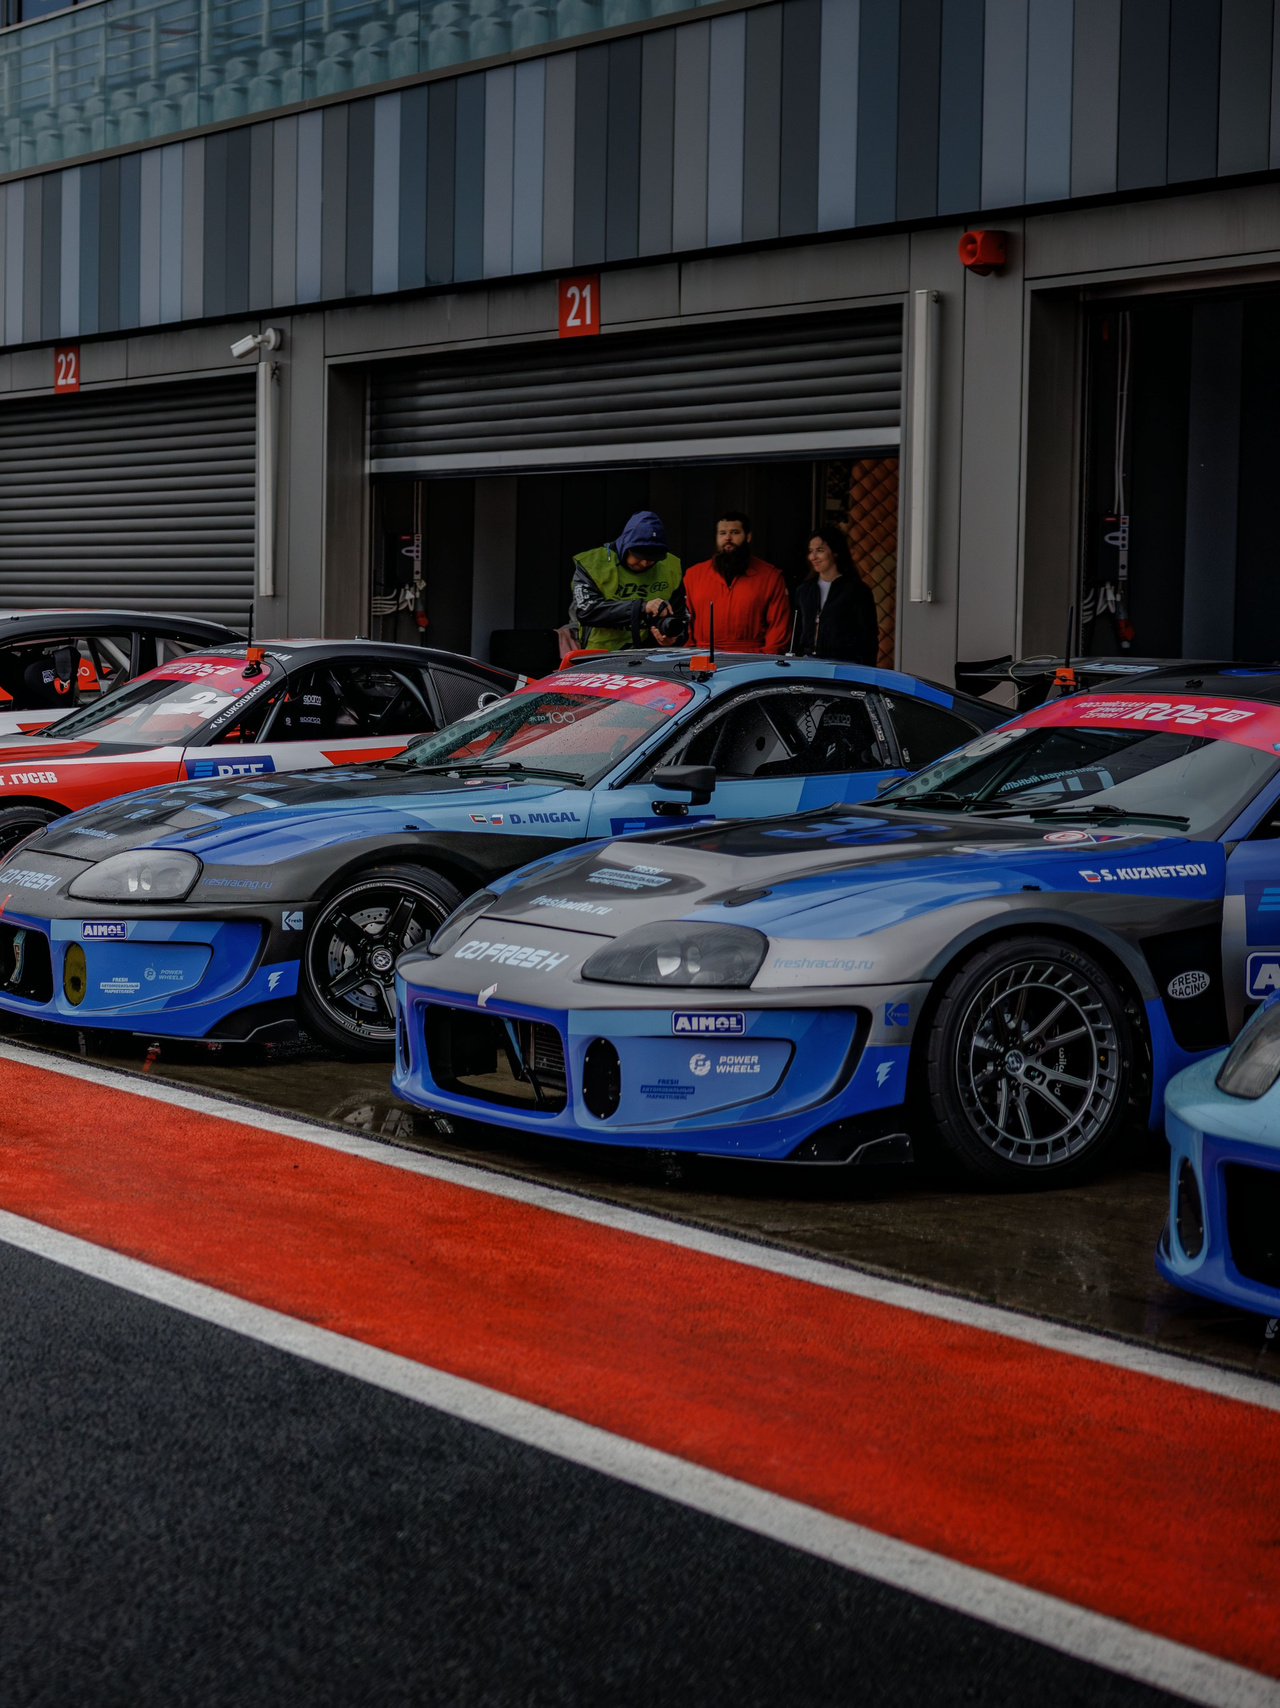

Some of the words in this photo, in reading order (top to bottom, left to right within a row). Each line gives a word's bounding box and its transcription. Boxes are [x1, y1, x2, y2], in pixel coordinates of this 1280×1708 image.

[566, 284, 592, 327] 21
[57, 352, 77, 386] 22
[650, 582, 669, 594] GP
[547, 711, 576, 724] 100
[823, 714, 851, 727] sparco
[509, 813, 526, 824] D.
[529, 812, 580, 824] MIGAL
[1100, 867, 1117, 881] S.
[1116, 863, 1207, 880] KUZNETSOV
[201, 876, 273, 890] freshracing.ru
[528, 895, 613, 916] freshauto.ru
[83, 924, 125, 937] AIMOL
[773, 957, 875, 971] freshracing.ru
[1172, 973, 1205, 988] FRESH
[1171, 982, 1207, 997] RACING
[675, 1015, 742, 1032] AIMOL
[719, 1055, 759, 1064] POWER
[716, 1065, 761, 1074] WHEELS
